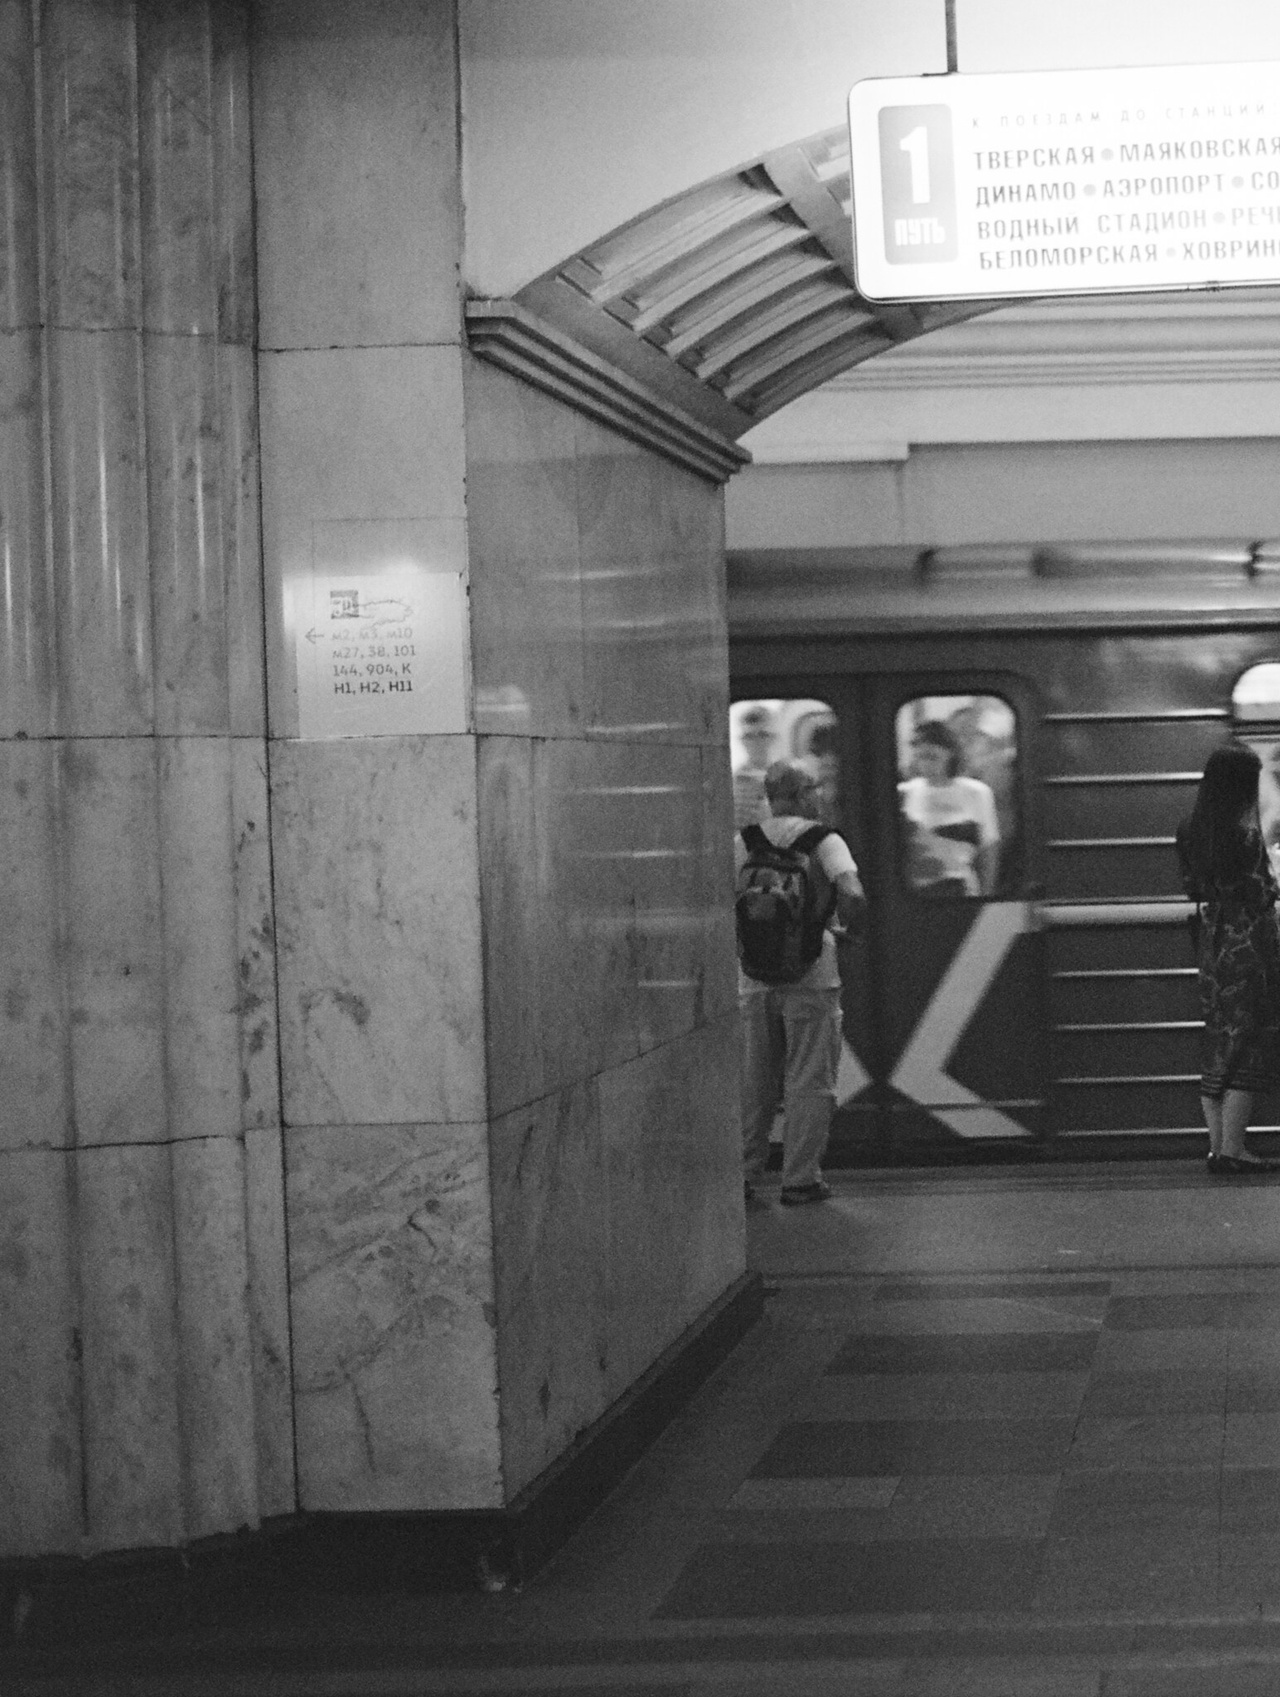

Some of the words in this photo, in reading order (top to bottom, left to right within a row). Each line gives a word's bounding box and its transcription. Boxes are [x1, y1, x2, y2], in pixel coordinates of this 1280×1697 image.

[971, 117, 980, 129] К
[1000, 111, 1100, 128] ПОЕЗДАМ
[1120, 109, 1147, 124] ДО
[900, 125, 930, 204] 1
[973, 145, 1095, 170] ТВЕРСКАЯ
[976, 181, 1076, 209] ДИНАМО
[1103, 173, 1224, 199] АЭРОПОРТ
[894, 217, 946, 247] ПУТЬ
[977, 212, 1080, 242] ВОДНЫЙ
[1097, 209, 1207, 235] СТАДИОН
[979, 243, 1158, 271] БЕЛОМОРСКАЯ
[394, 644, 416, 657] 101
